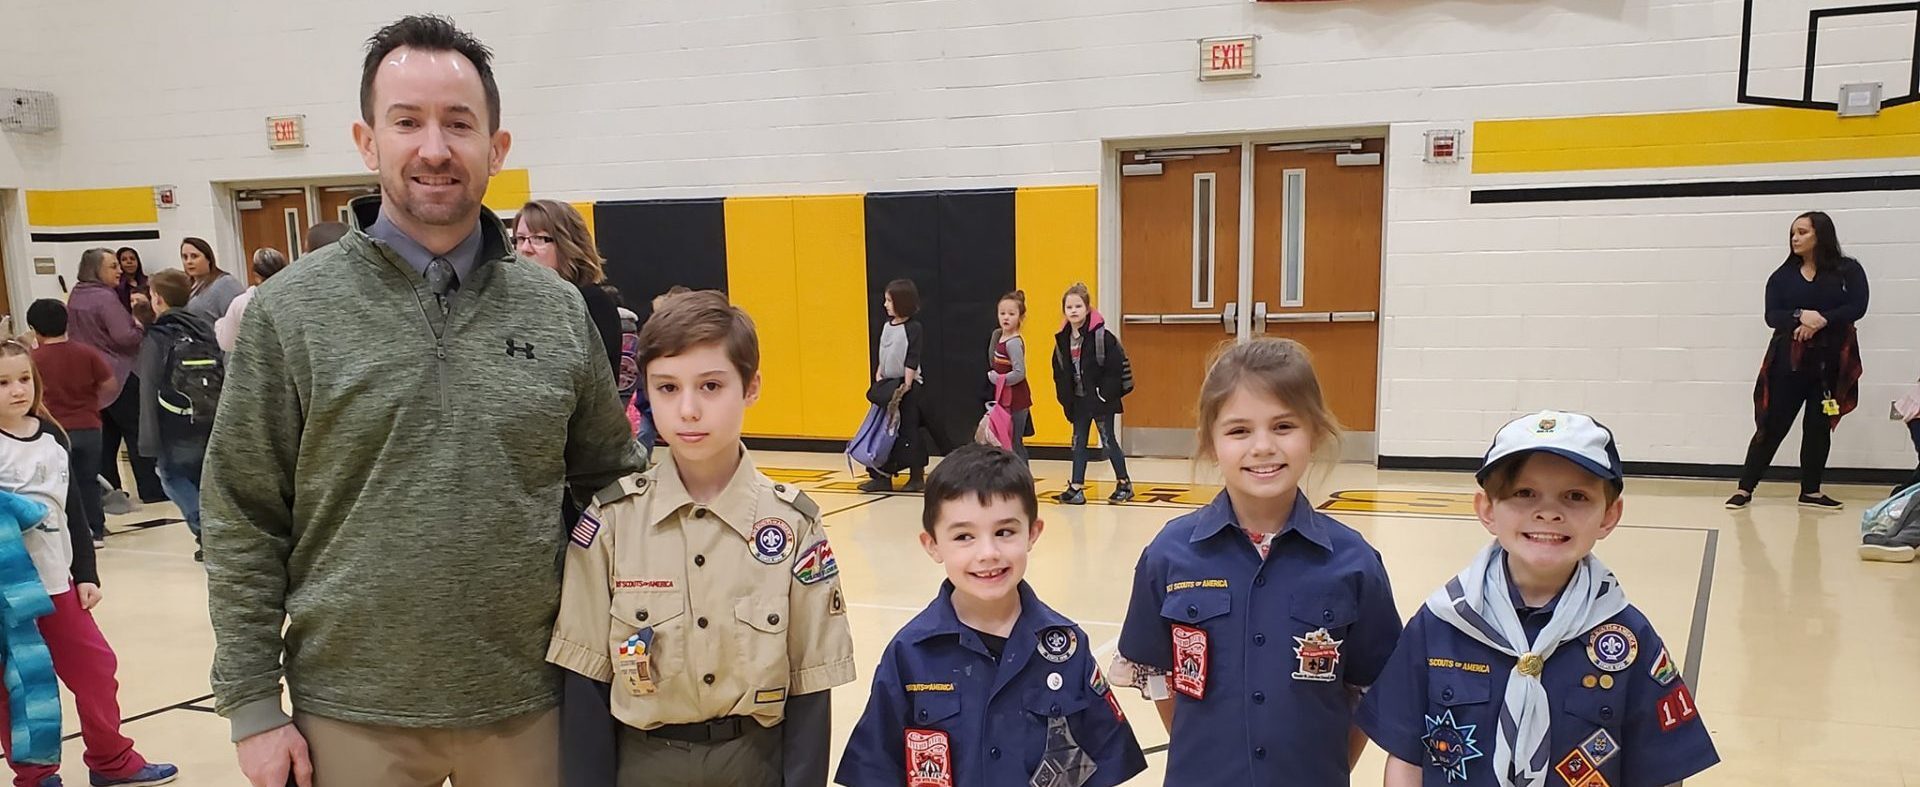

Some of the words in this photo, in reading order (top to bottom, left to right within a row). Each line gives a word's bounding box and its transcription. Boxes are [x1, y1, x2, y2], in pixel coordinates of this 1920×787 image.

[1212, 44, 1244, 70] EXIT
[1202, 579, 1228, 588] AMERICA
[1428, 658, 1454, 668] SCOUTS
[1462, 662, 1490, 674] AMERICA
